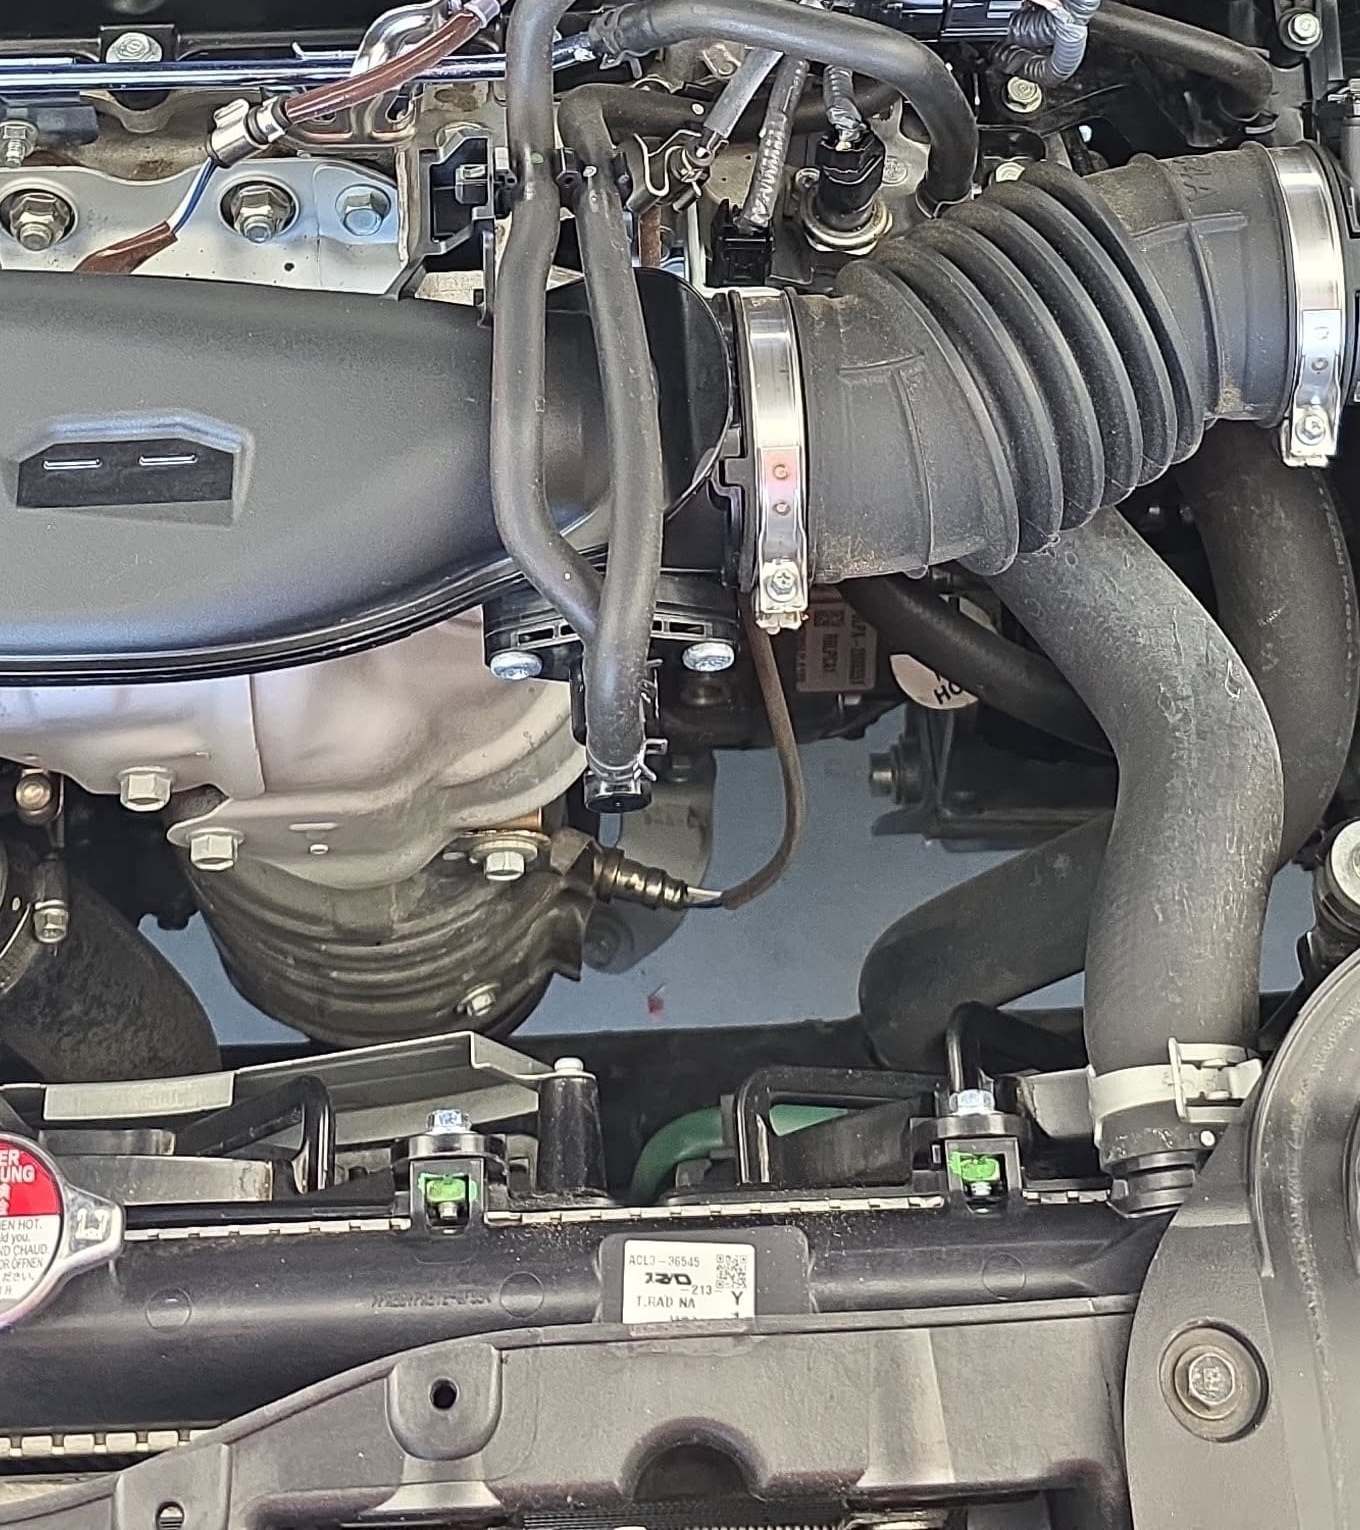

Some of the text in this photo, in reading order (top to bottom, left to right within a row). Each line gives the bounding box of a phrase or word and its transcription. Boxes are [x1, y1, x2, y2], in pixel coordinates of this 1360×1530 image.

[17, 1218, 43, 1230] HOT.
[10, 1233, 32, 1246] you.
[636, 1295, 674, 1309] T.RAD
[678, 1297, 696, 1309] NA
